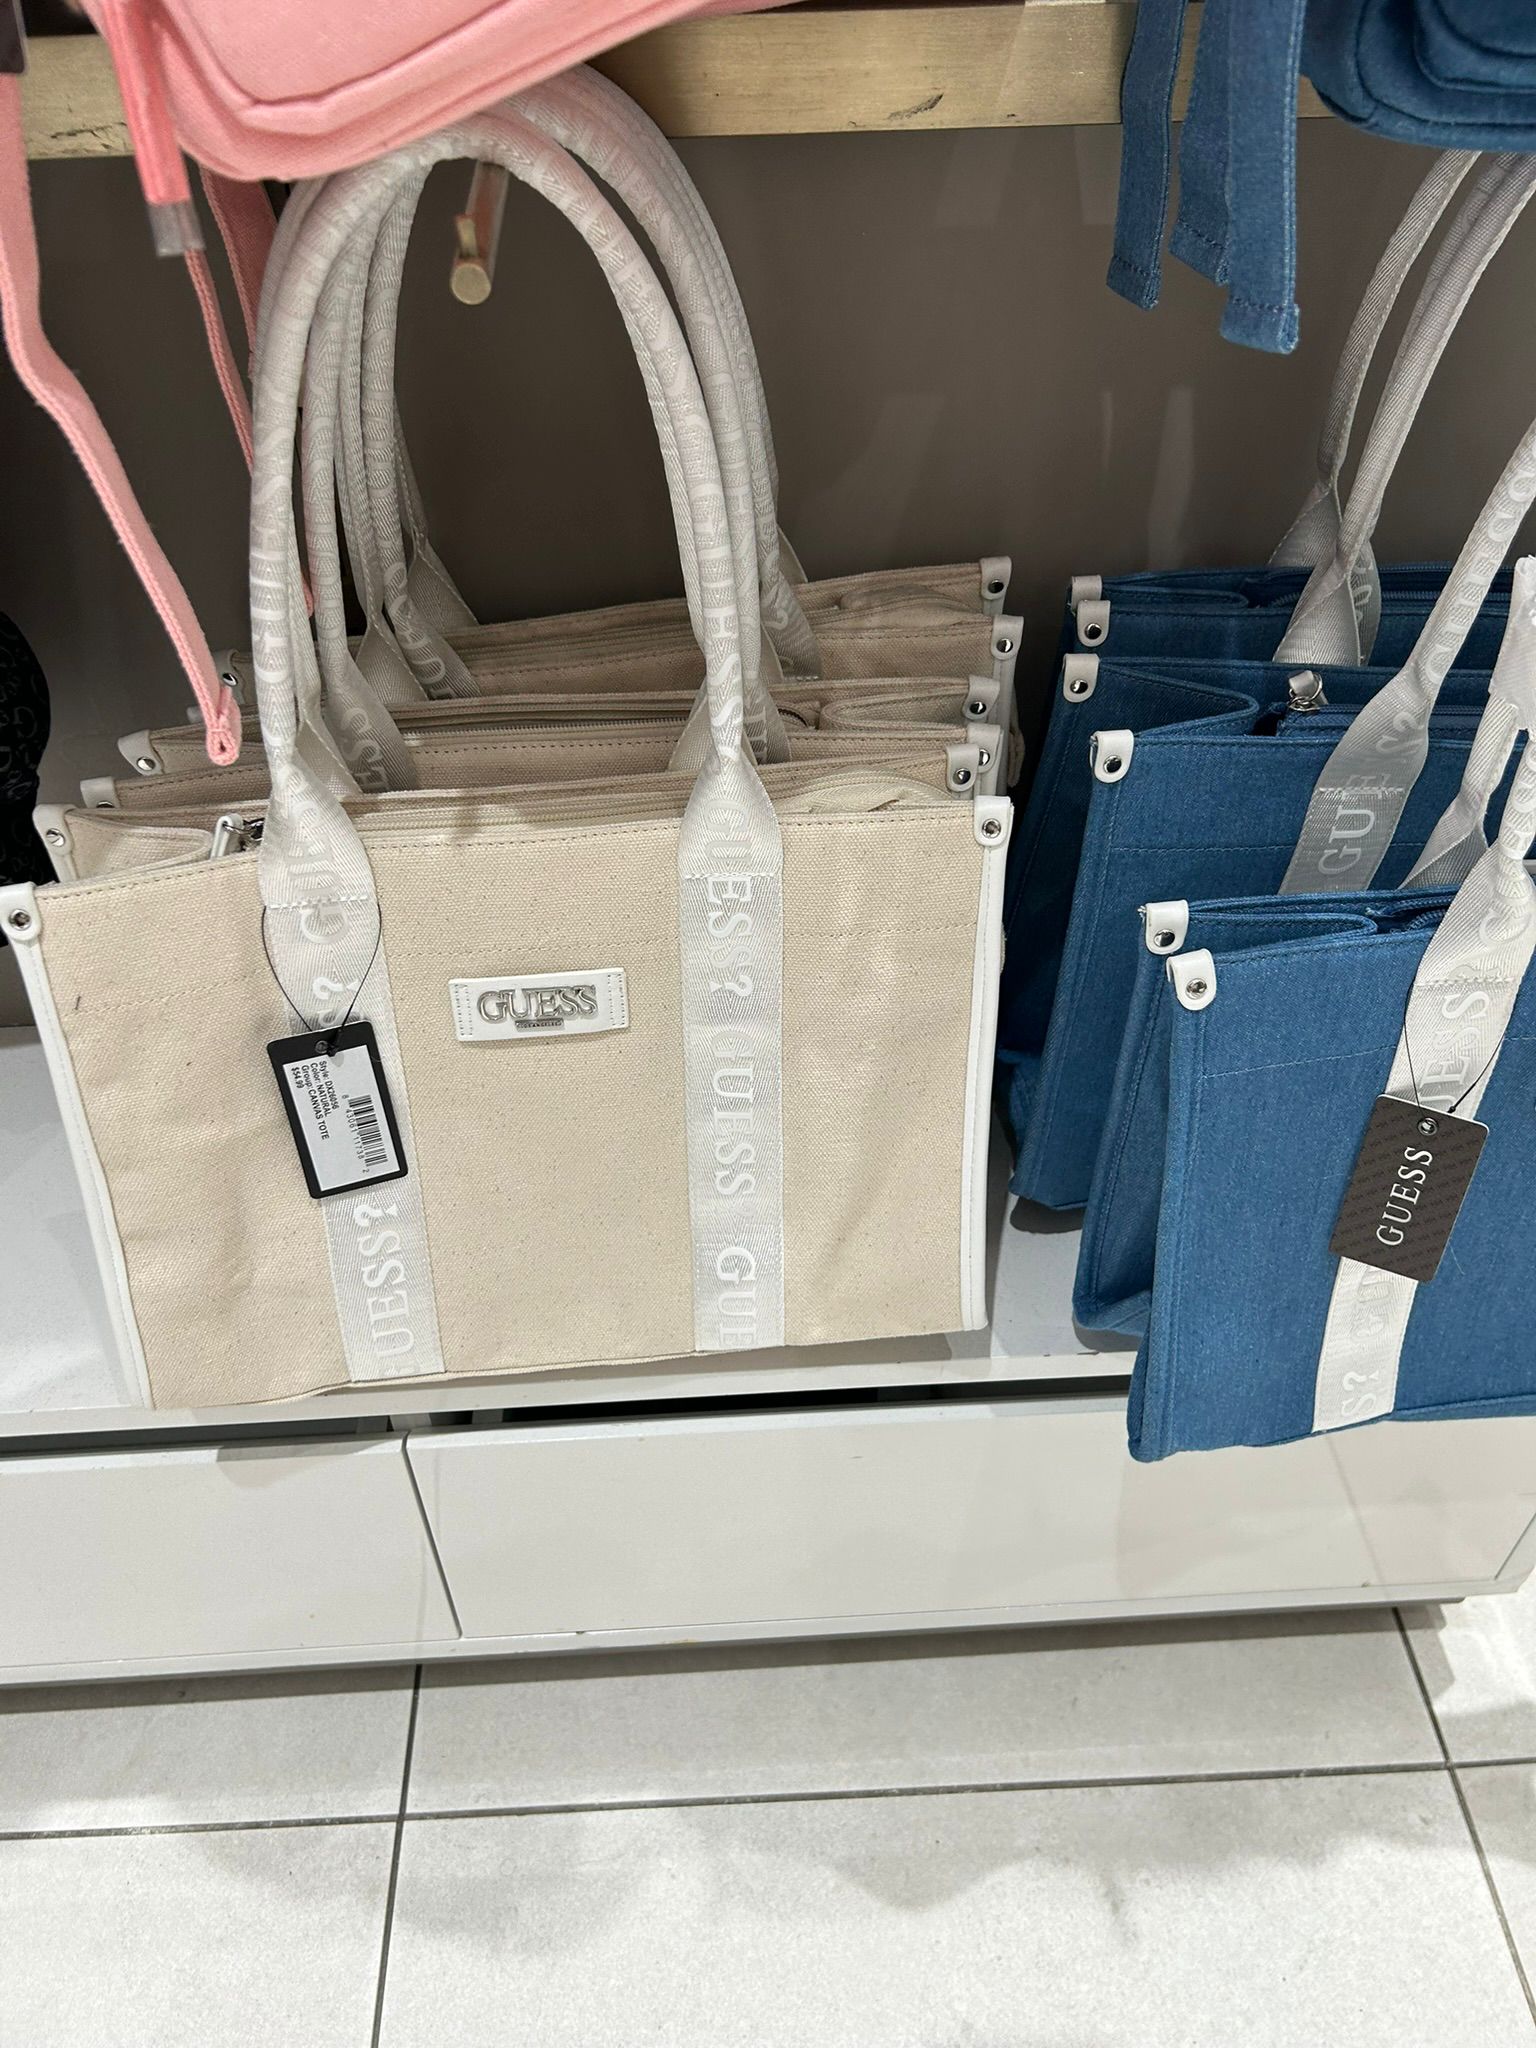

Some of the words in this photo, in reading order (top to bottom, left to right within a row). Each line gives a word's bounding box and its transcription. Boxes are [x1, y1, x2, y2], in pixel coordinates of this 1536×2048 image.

[477, 984, 599, 1024] GUESS
[290, 1066, 305, 1090] $54.99
[310, 1062, 321, 1085] Color:
[316, 1083, 333, 1118] NATURAL
[318, 1060, 330, 1082] Style:
[301, 1064, 314, 1090] Group:
[308, 1088, 323, 1120] CANVAS
[317, 1119, 330, 1141] TOTE
[1374, 1145, 1435, 1247] GUESS
